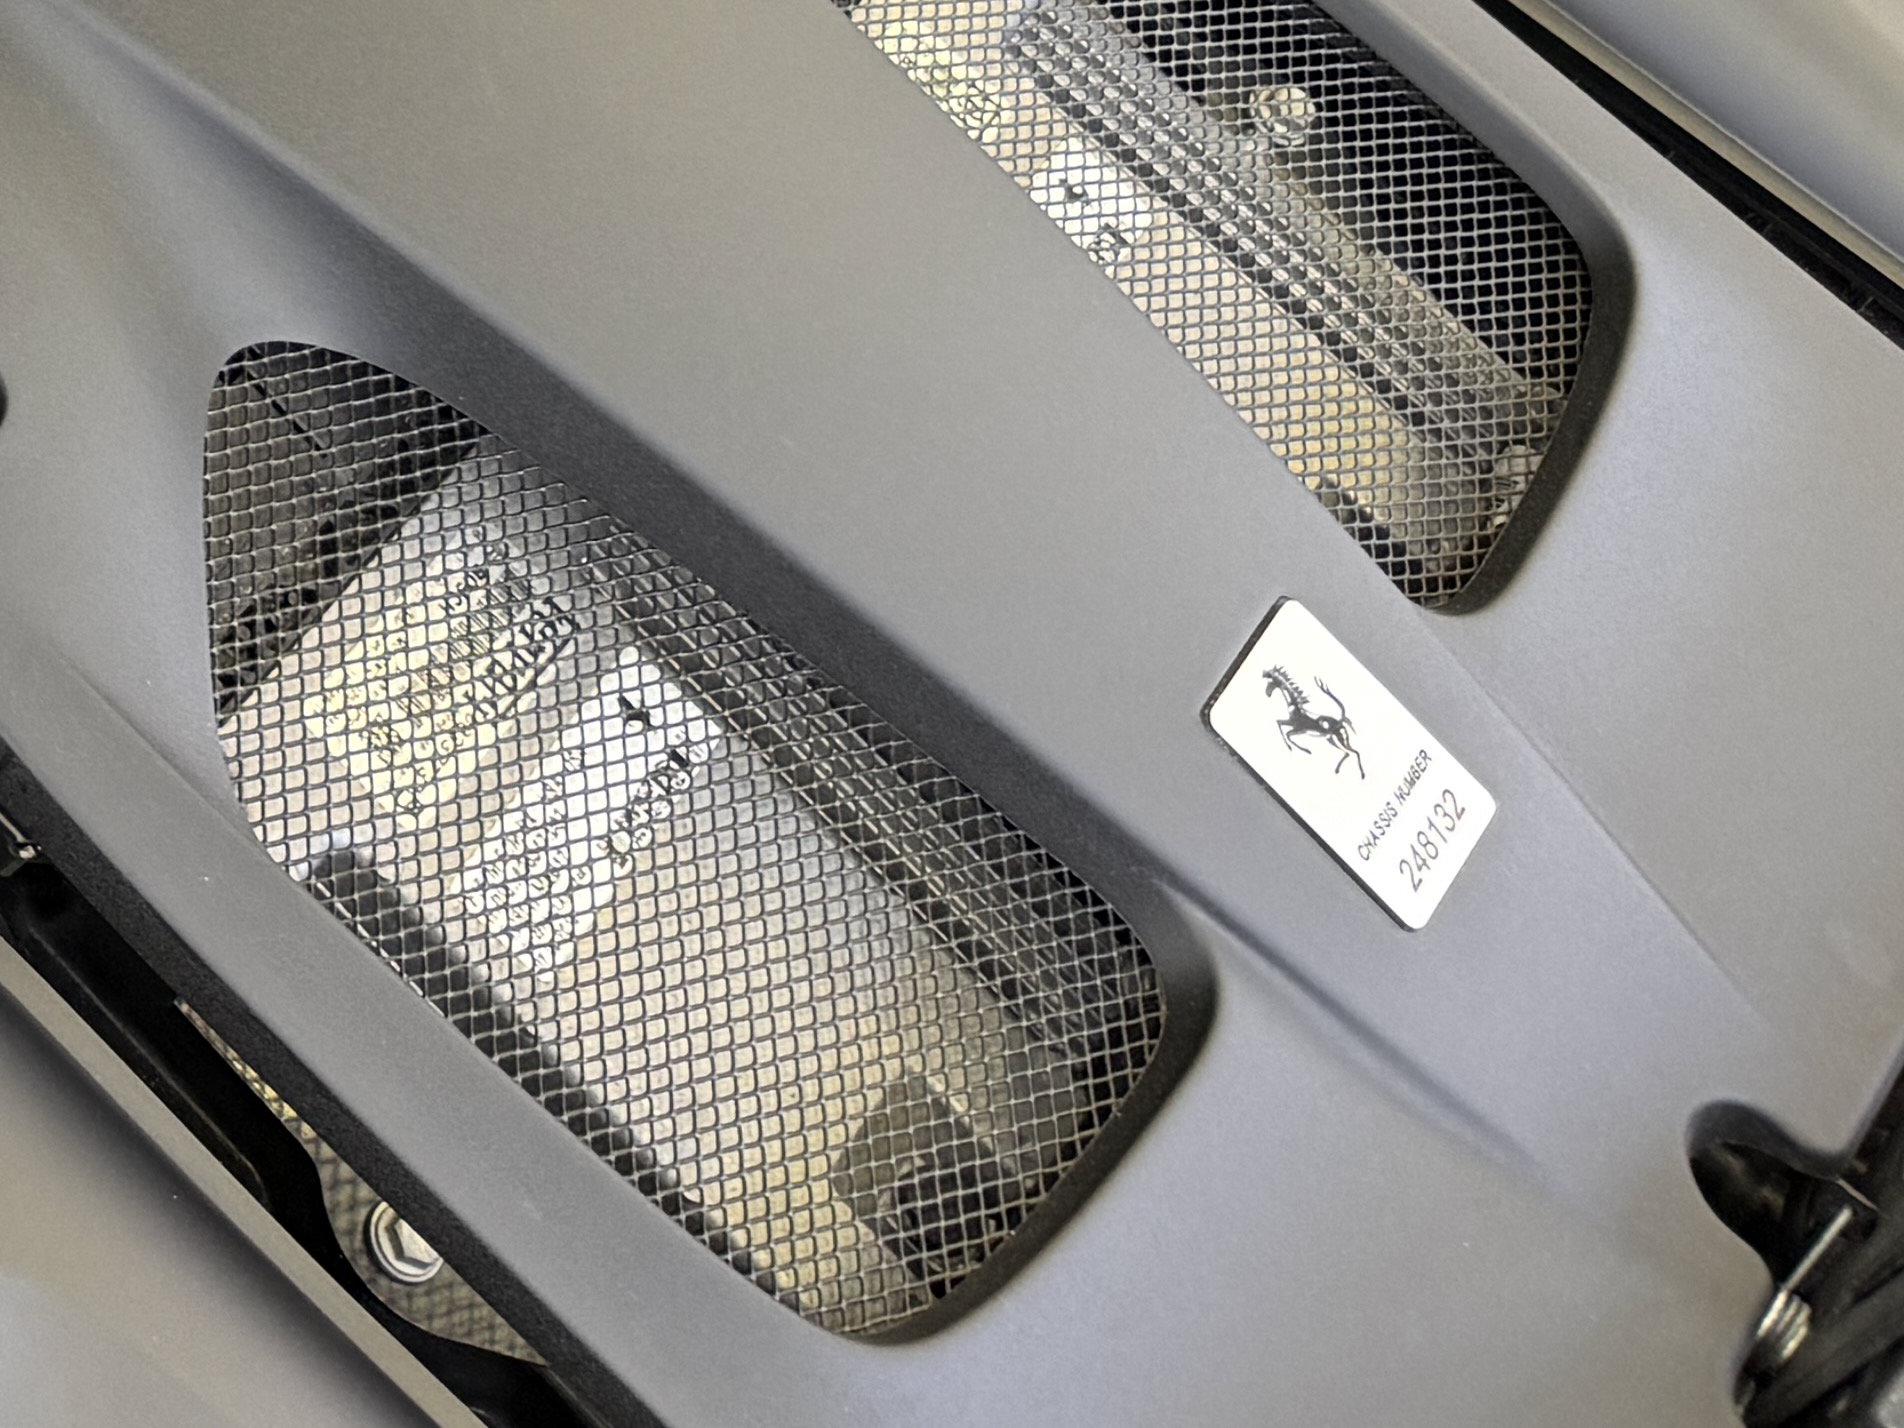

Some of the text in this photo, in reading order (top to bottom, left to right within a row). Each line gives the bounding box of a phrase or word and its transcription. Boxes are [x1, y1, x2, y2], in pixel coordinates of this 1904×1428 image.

[1357, 748, 1433, 862] CHASSIS NUMBER
[1398, 788, 1467, 894] 248132
